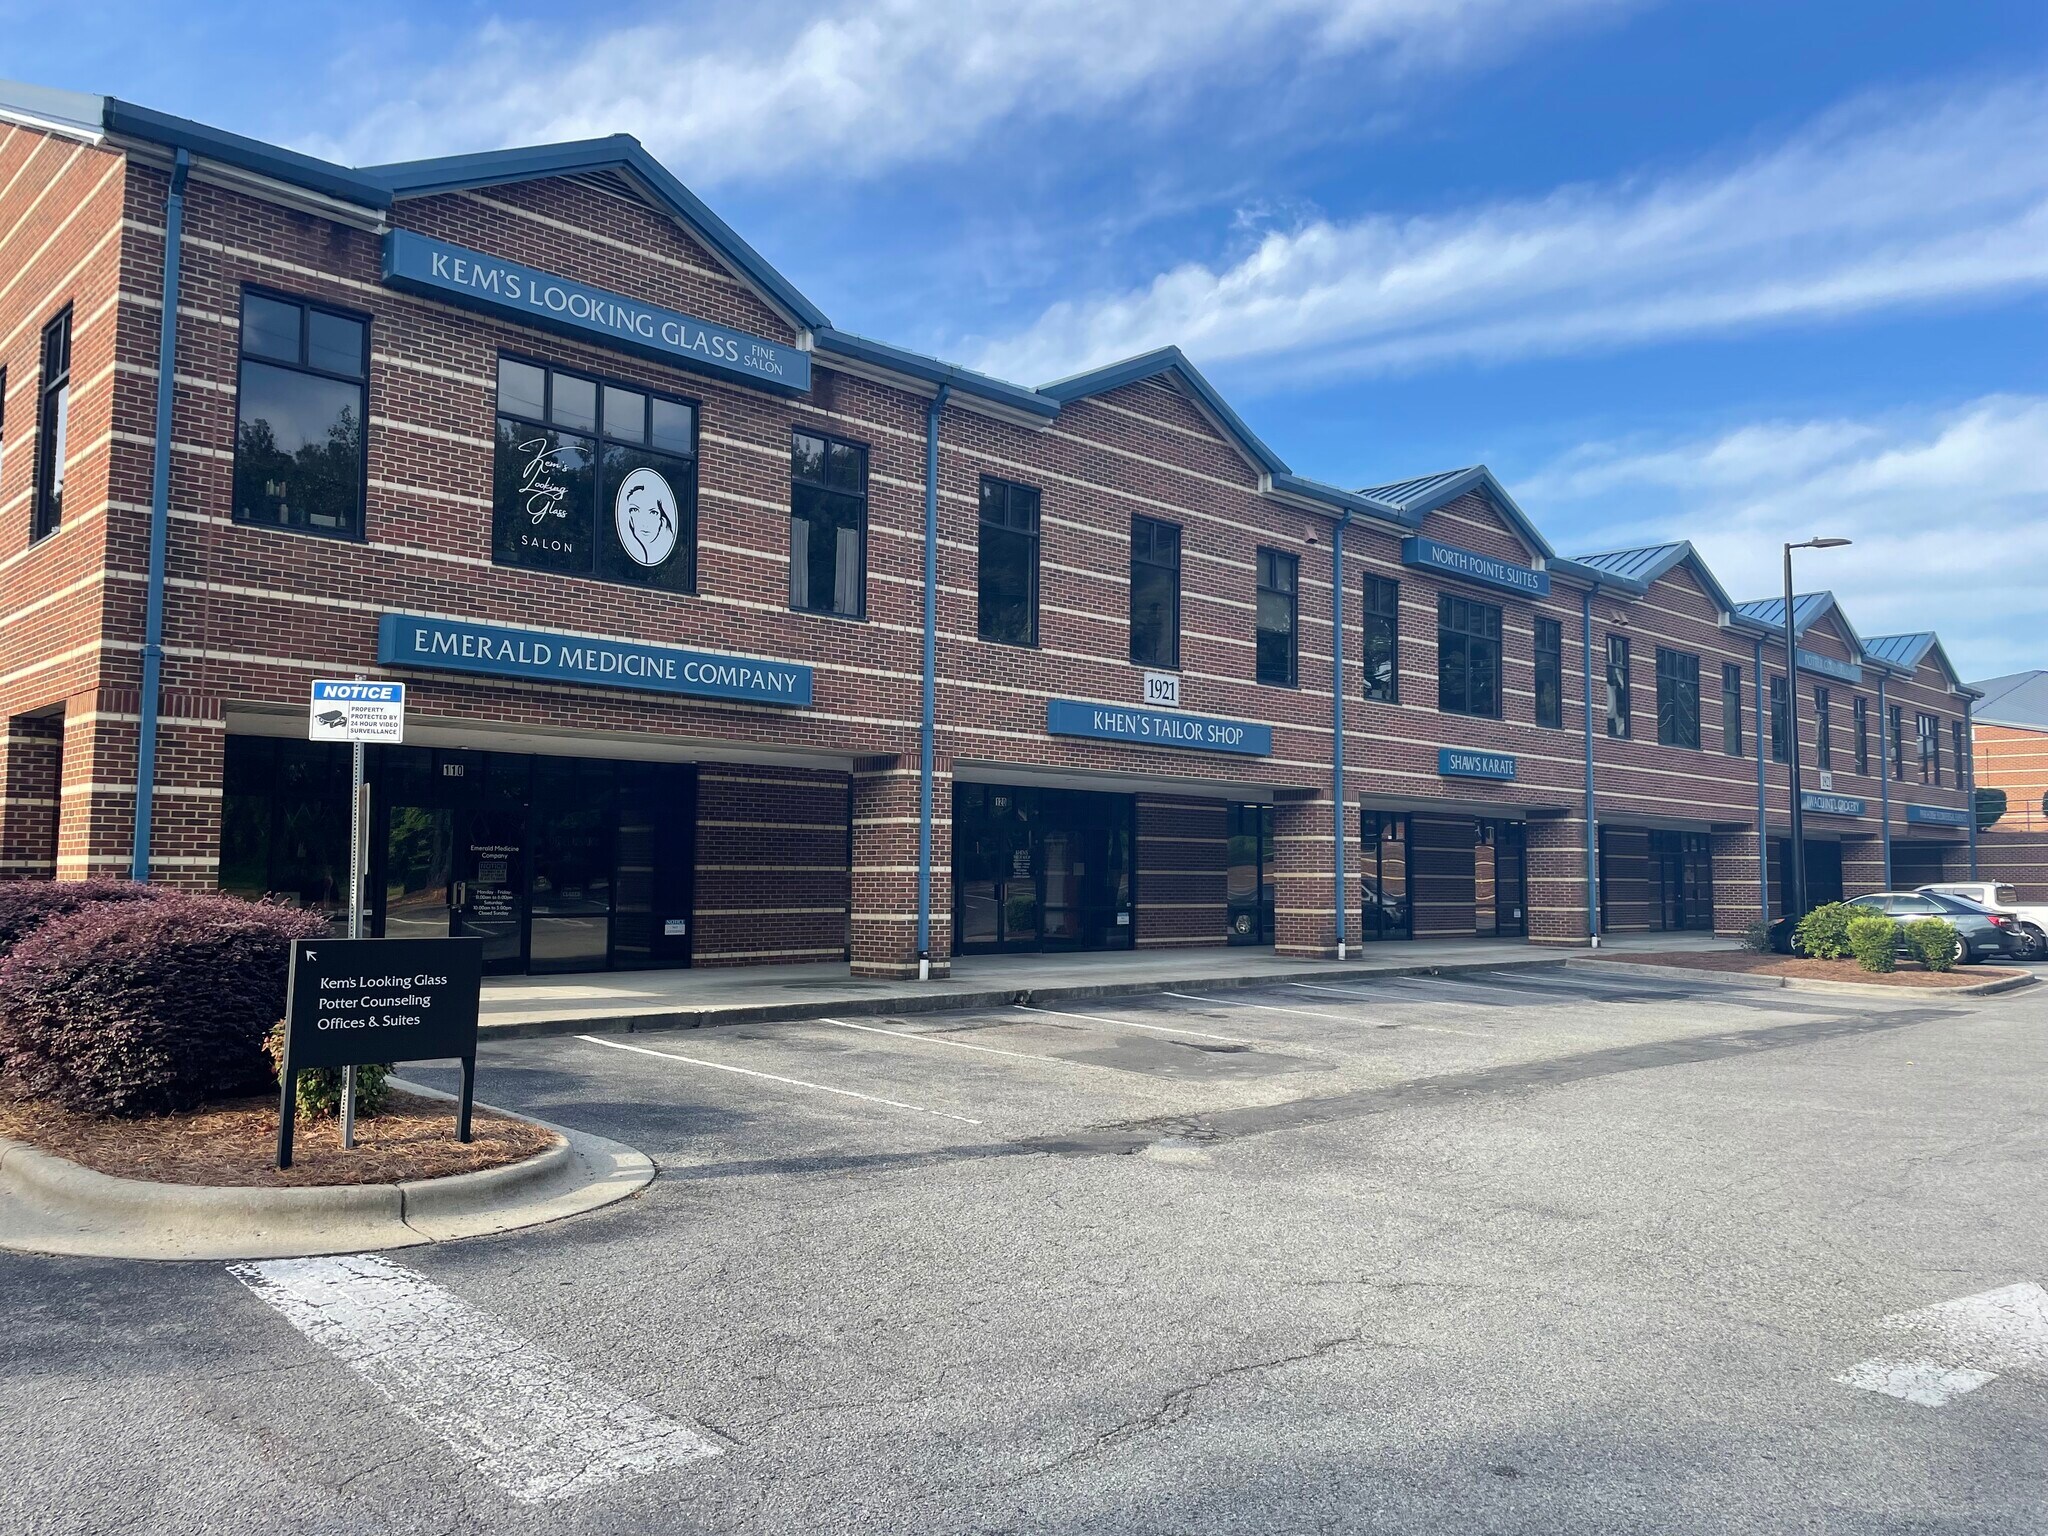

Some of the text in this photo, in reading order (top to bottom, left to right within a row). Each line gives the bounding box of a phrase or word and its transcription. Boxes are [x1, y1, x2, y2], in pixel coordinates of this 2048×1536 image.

[432, 252, 739, 362] KEM'S LOOKING GLASS
[751, 344, 776, 361] FINE
[743, 355, 783, 376] SALON
[521, 535, 573, 552] SALON
[1432, 546, 1539, 589] NORTH POINTE SUITES
[414, 629, 797, 693] EMERALD MEDICINE COMPANY
[323, 685, 393, 699] NOTICE
[1148, 678, 1176, 701] 1921
[1094, 710, 1244, 745] KHEN'S TAILOR SHOP
[445, 765, 463, 776] 110
[1482, 757, 1514, 775] KARATE
[320, 973, 448, 990] Kem's Looking Glass
[318, 994, 431, 1009] Potter Counseling
[317, 1014, 421, 1030] Offices & Suites
